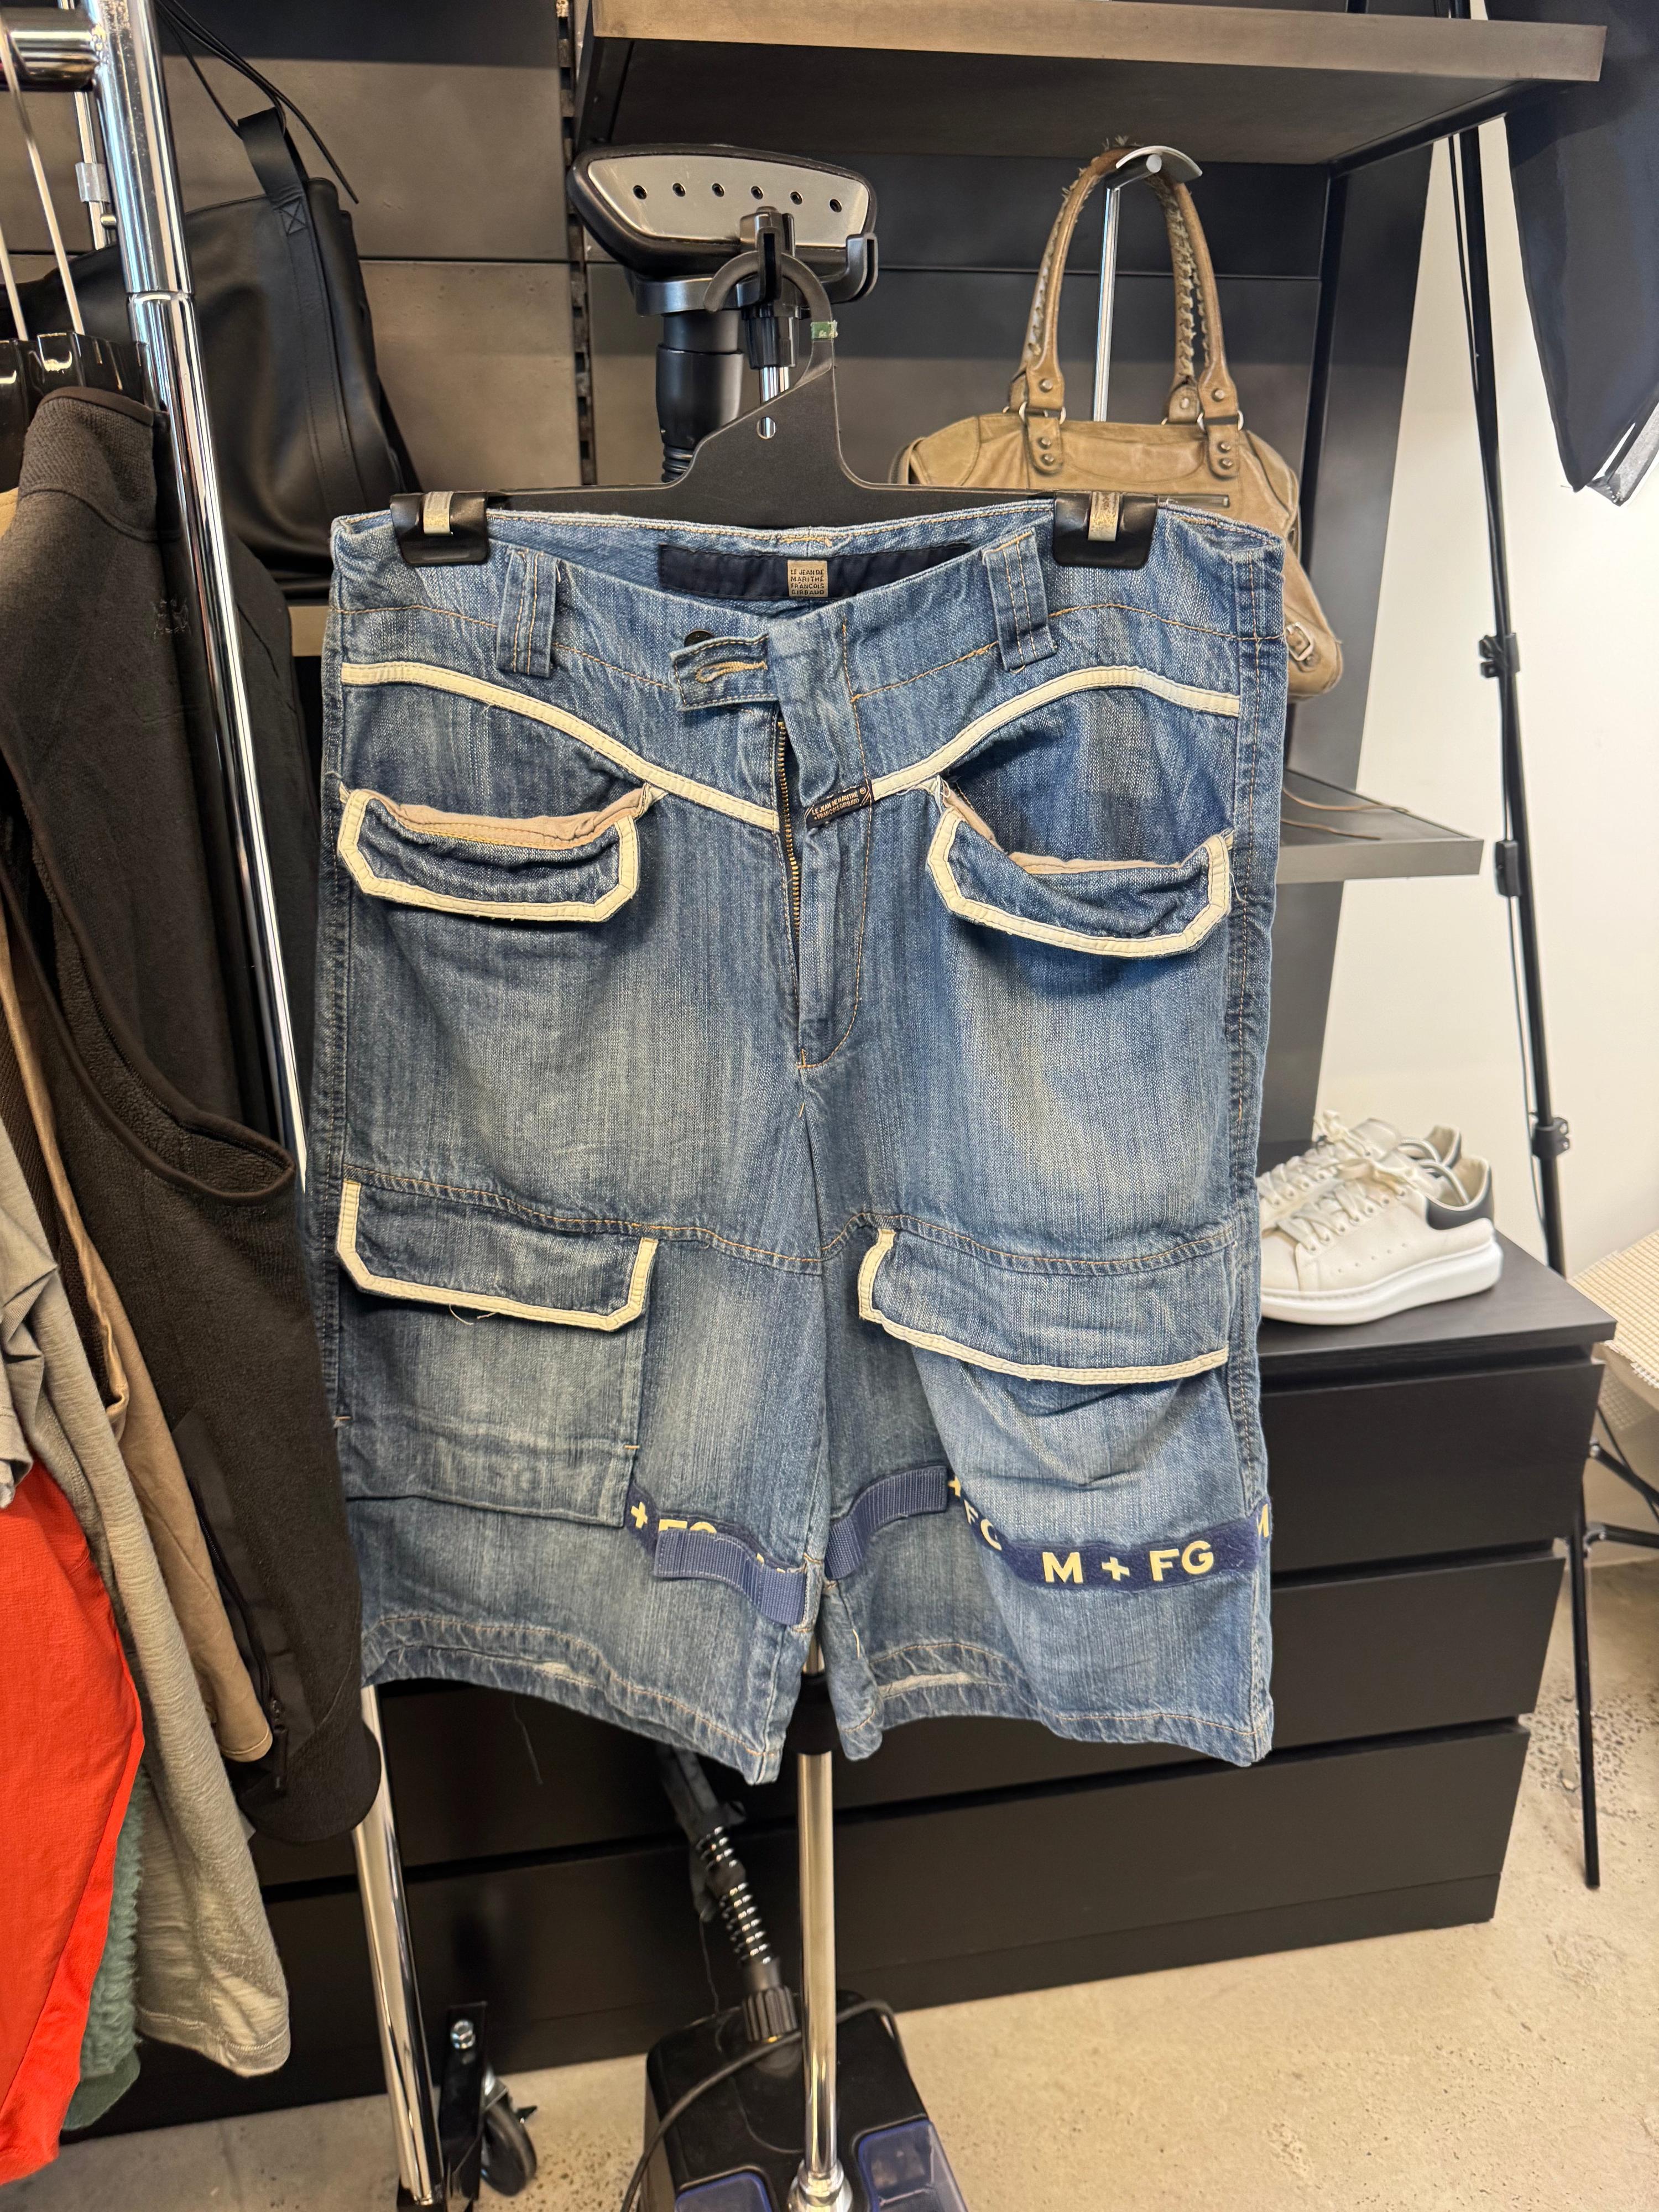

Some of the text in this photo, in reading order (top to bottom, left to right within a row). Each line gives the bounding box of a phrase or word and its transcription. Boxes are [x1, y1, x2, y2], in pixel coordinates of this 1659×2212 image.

[819, 802, 832, 812] JEAN
[831, 799, 838, 807] DE
[1042, 1552, 1083, 1584] M
[1149, 1540, 1214, 1582] FG
